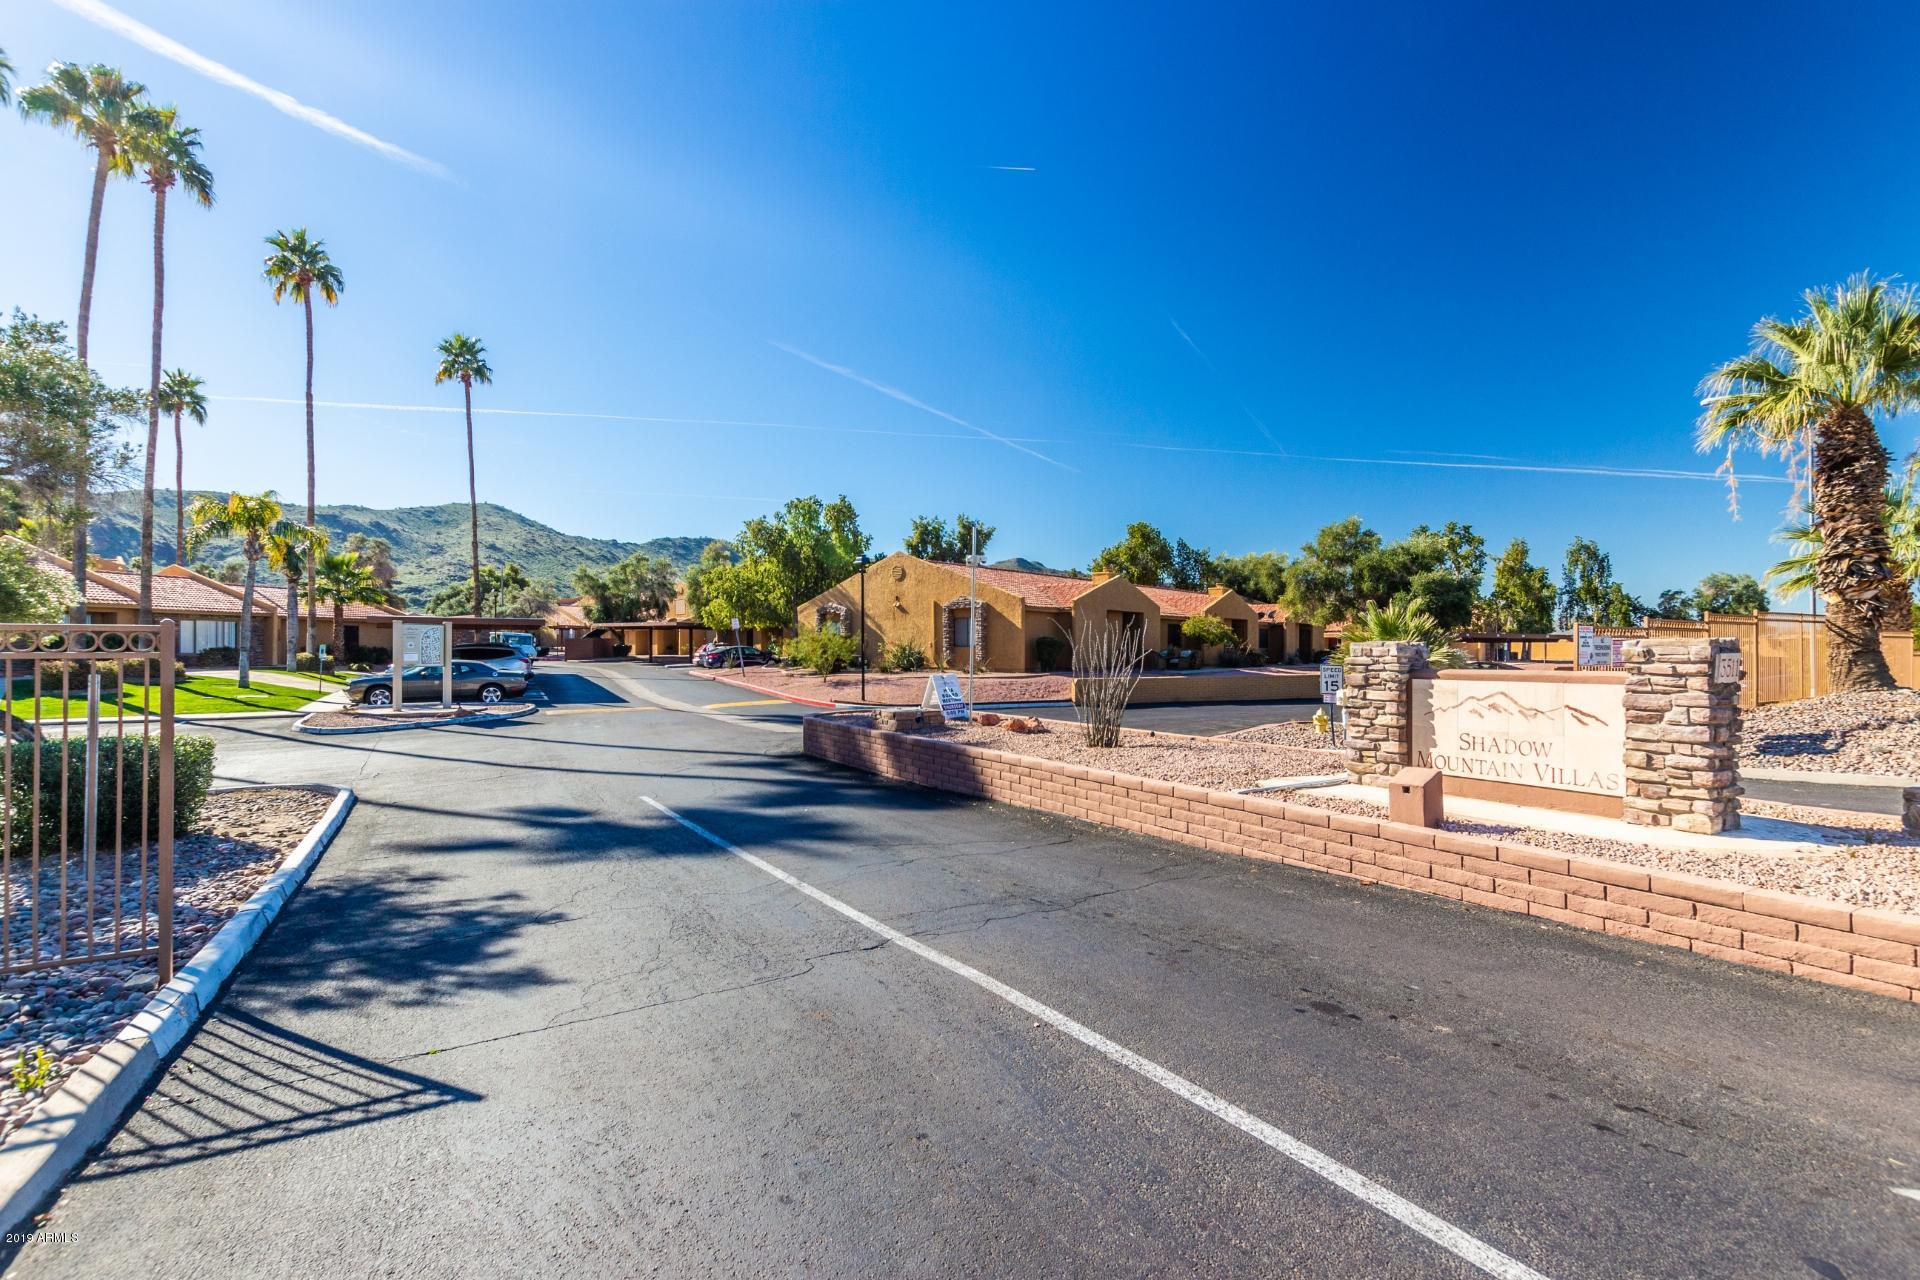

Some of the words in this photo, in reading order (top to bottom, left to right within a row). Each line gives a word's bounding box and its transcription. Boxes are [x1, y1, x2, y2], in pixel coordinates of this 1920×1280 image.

[1324, 680, 1339, 691] 15
[1459, 732, 1553, 758] SHADOW
[1416, 750, 1524, 779] MOUNTAIN
[1532, 762, 1620, 791] VILLAS
